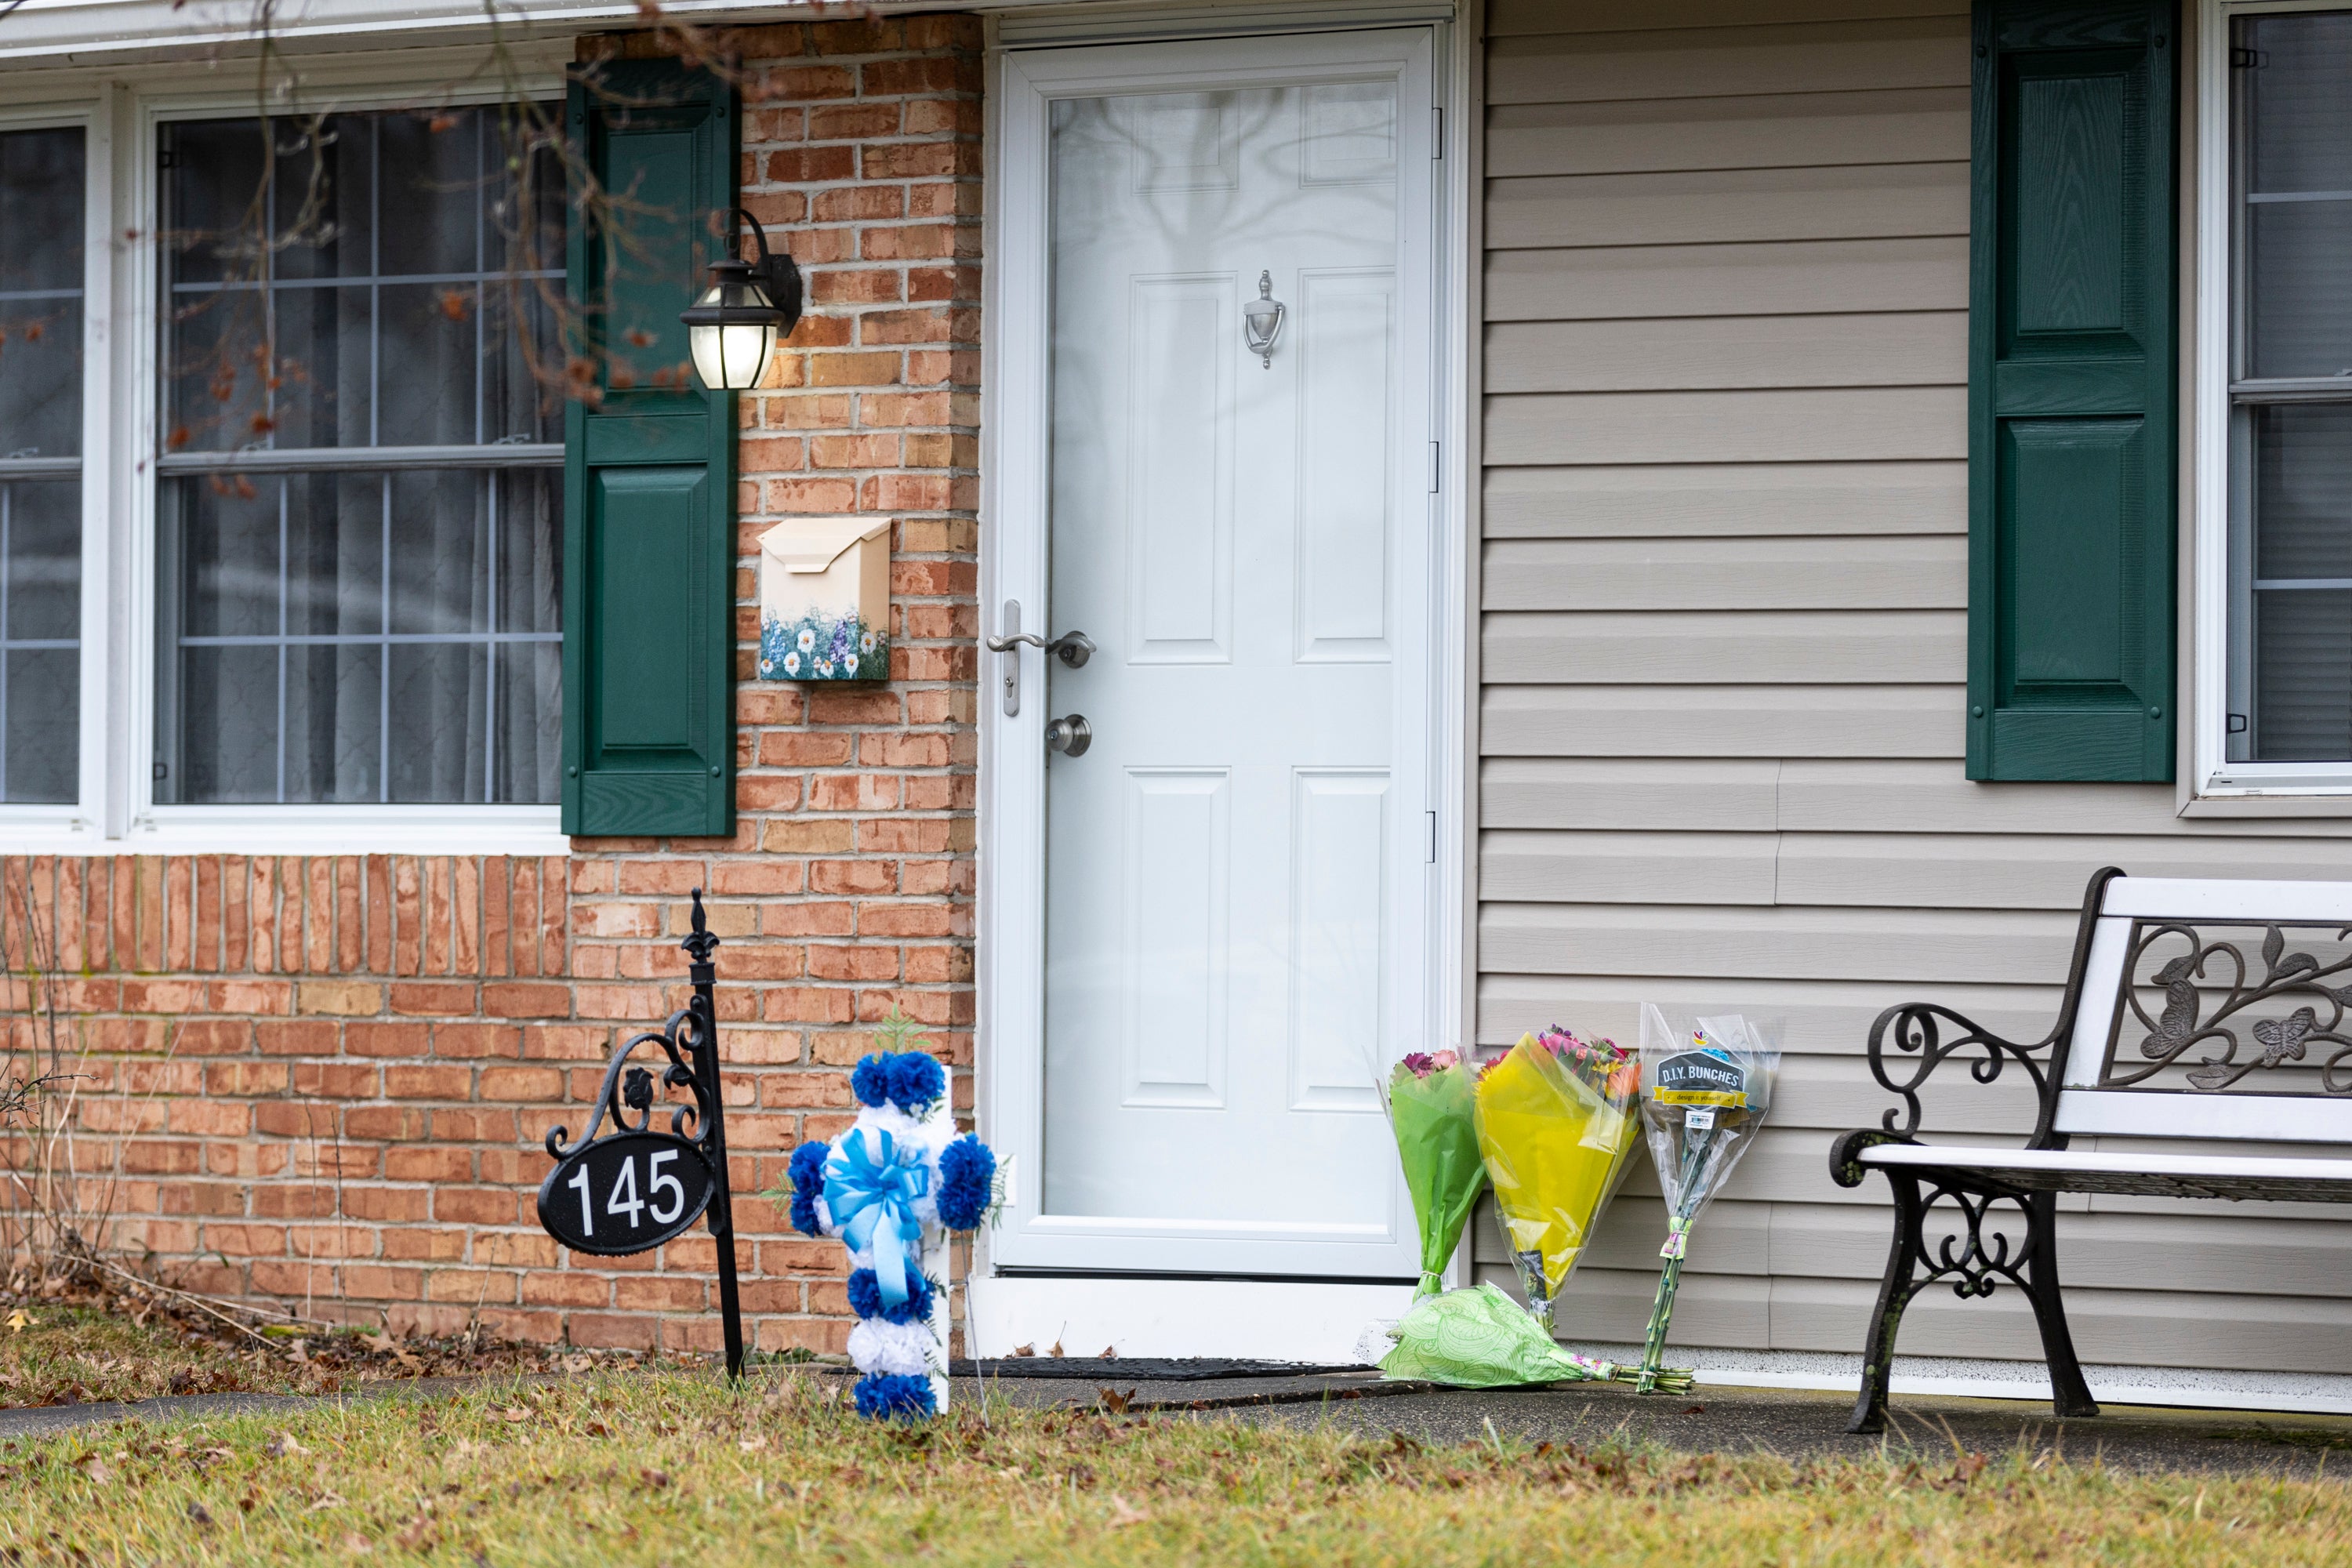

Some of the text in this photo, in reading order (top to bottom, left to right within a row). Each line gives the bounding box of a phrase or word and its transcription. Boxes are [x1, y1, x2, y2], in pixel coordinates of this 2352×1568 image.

[1662, 1065, 1740, 1087] D.I.Y. BUNCHES
[568, 1149, 685, 1236] 145
